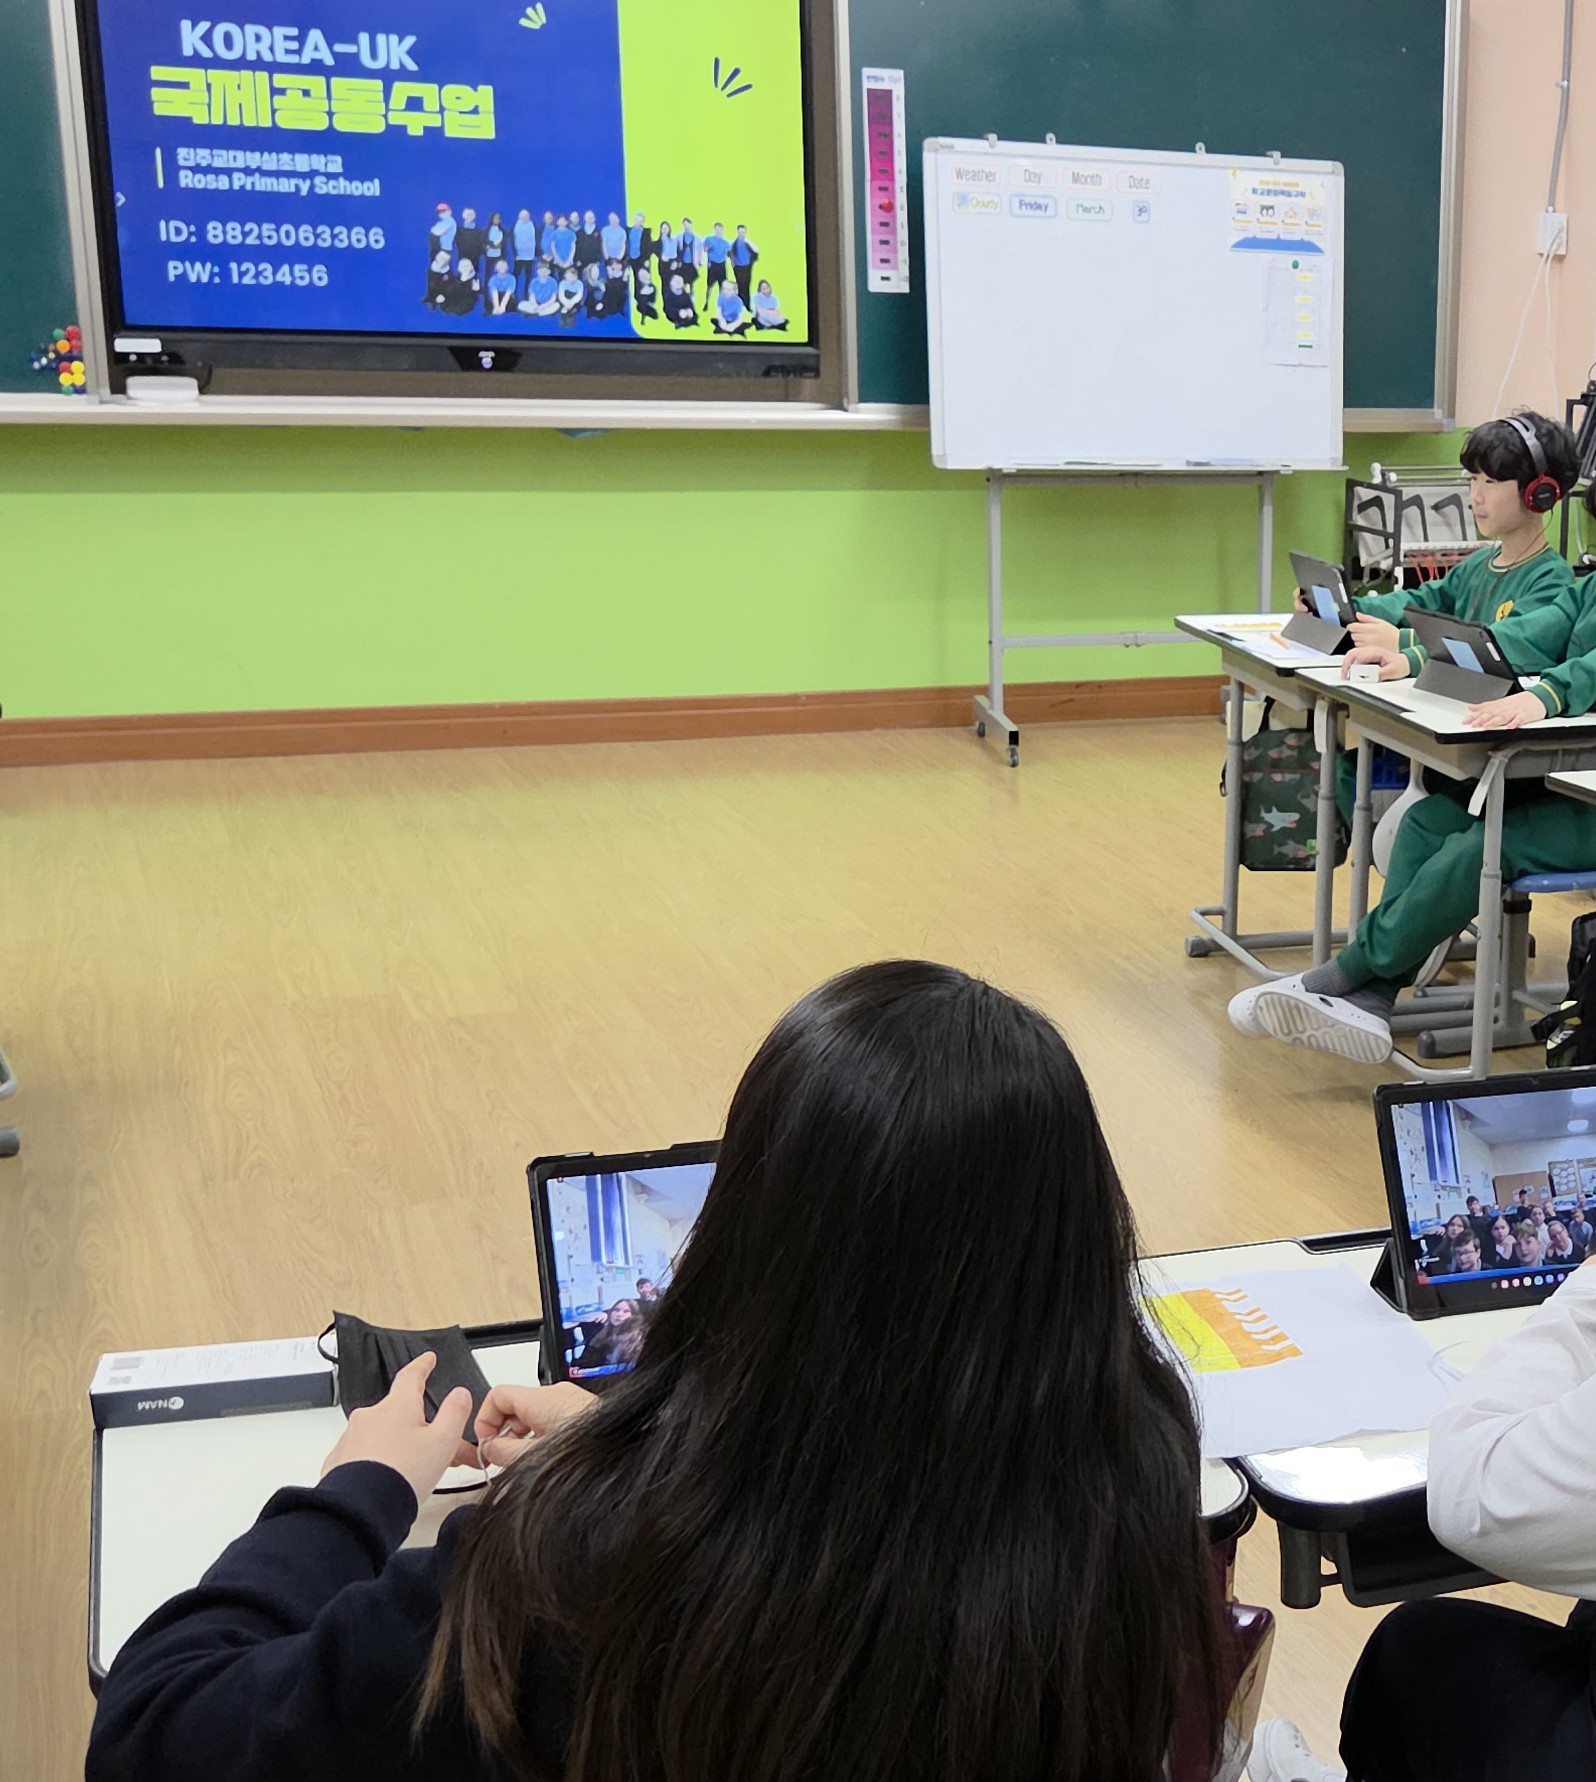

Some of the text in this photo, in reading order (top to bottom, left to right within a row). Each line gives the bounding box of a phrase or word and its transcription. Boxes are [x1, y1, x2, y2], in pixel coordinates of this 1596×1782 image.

[180, 19, 419, 71] KOREA-UK
[150, 66, 496, 139] 국제공동수업
[177, 146, 343, 173] 진주교대부설초등학교
[179, 169, 381, 197] Rosa Primary School
[955, 166, 997, 182] Weather
[1023, 168, 1042, 184] Day
[1071, 171, 1102, 187] Month
[1128, 174, 1151, 190] Date
[1018, 199, 1049, 214] Friday
[1075, 201, 1105, 215] March
[160, 219, 386, 249] ID: 8825063366
[167, 260, 329, 287] PW: 123456
